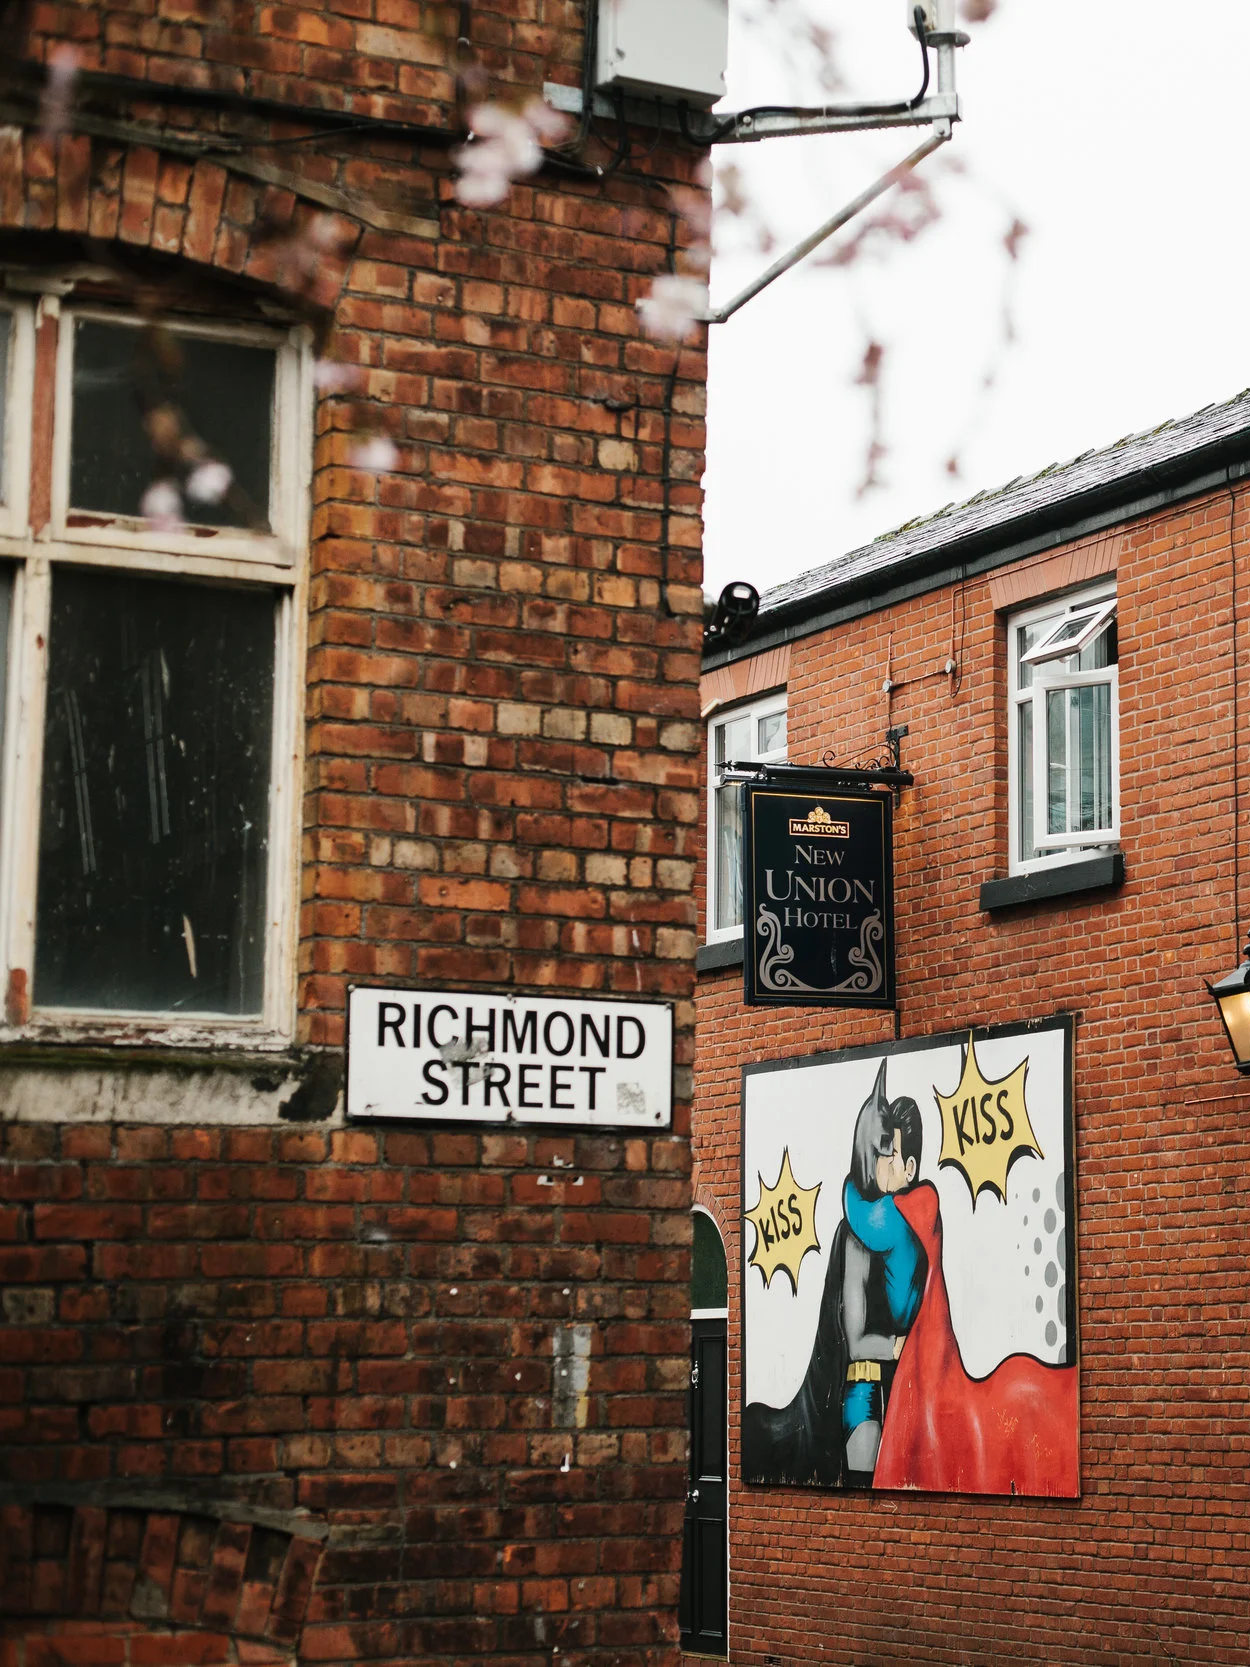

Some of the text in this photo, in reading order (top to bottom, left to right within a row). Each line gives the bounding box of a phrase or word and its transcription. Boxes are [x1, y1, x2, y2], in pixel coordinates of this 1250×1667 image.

[792, 823, 847, 834] MARSTON'S
[794, 844, 845, 866] NEW
[764, 868, 876, 905] UNION
[783, 906, 858, 930] HOTEL
[376, 1001, 646, 1060] RICHMOND
[420, 1059, 607, 1111] STREET
[952, 1089, 1014, 1156] KISS
[758, 1193, 803, 1253] KISS
